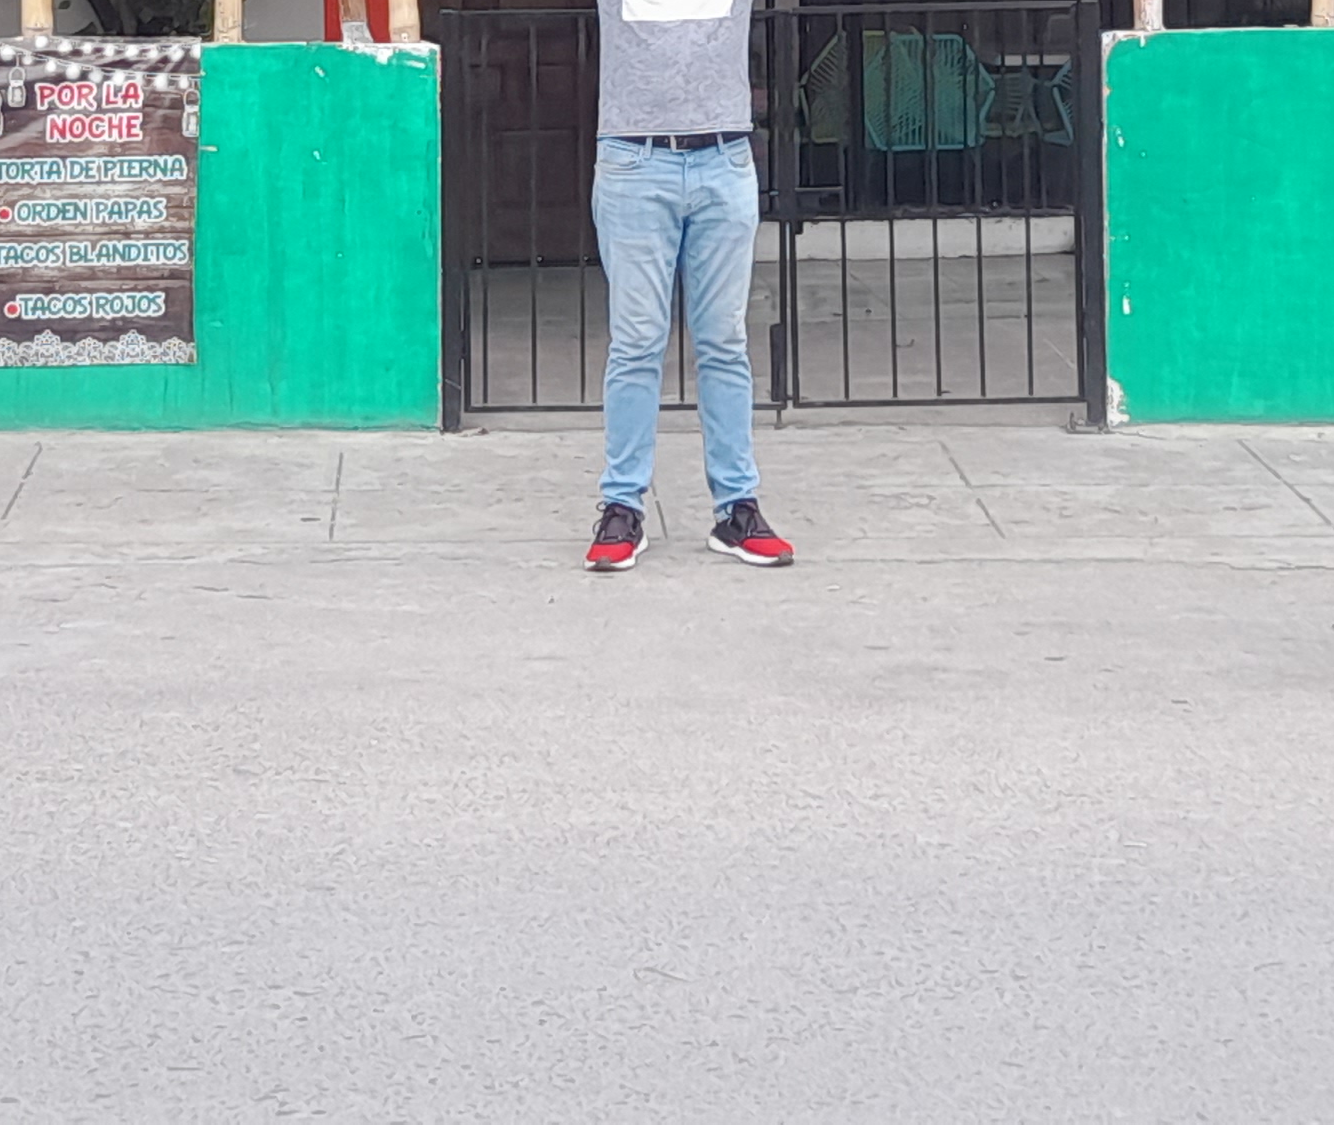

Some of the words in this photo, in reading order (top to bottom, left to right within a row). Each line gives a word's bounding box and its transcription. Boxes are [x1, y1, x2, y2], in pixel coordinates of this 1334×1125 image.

[35, 82, 97, 111] POR
[102, 81, 143, 108] LA
[46, 113, 142, 142] NOCHE
[67, 156, 99, 181] DE
[101, 155, 187, 182] PIERNA
[14, 200, 90, 225] ORDEN
[92, 198, 167, 223] PAPAS
[66, 240, 189, 266] BLANDITOS
[16, 294, 90, 320] TACOS
[92, 292, 165, 318] ROJOS
